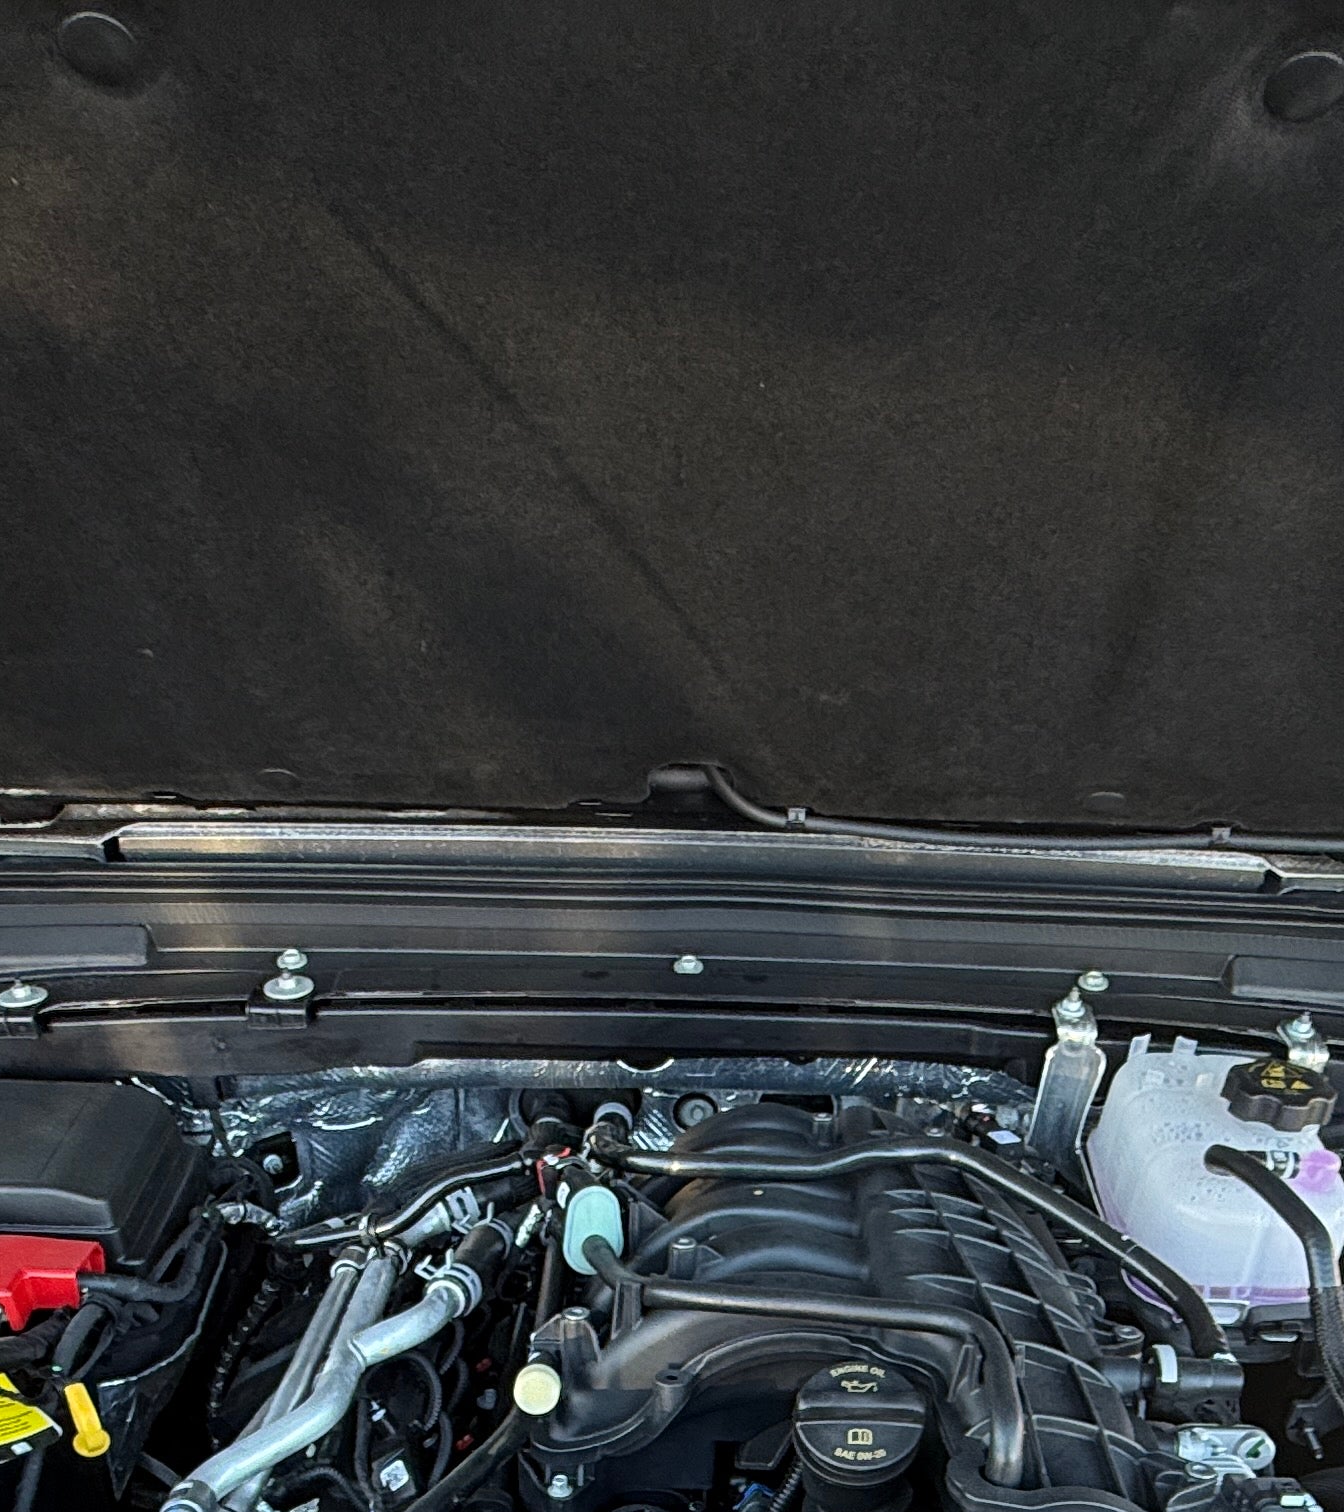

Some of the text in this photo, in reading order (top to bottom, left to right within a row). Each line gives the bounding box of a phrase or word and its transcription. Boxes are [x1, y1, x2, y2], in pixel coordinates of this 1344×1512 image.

[829, 1365, 886, 1378] ENGINE OIL
[834, 1448, 856, 1460] SAE
